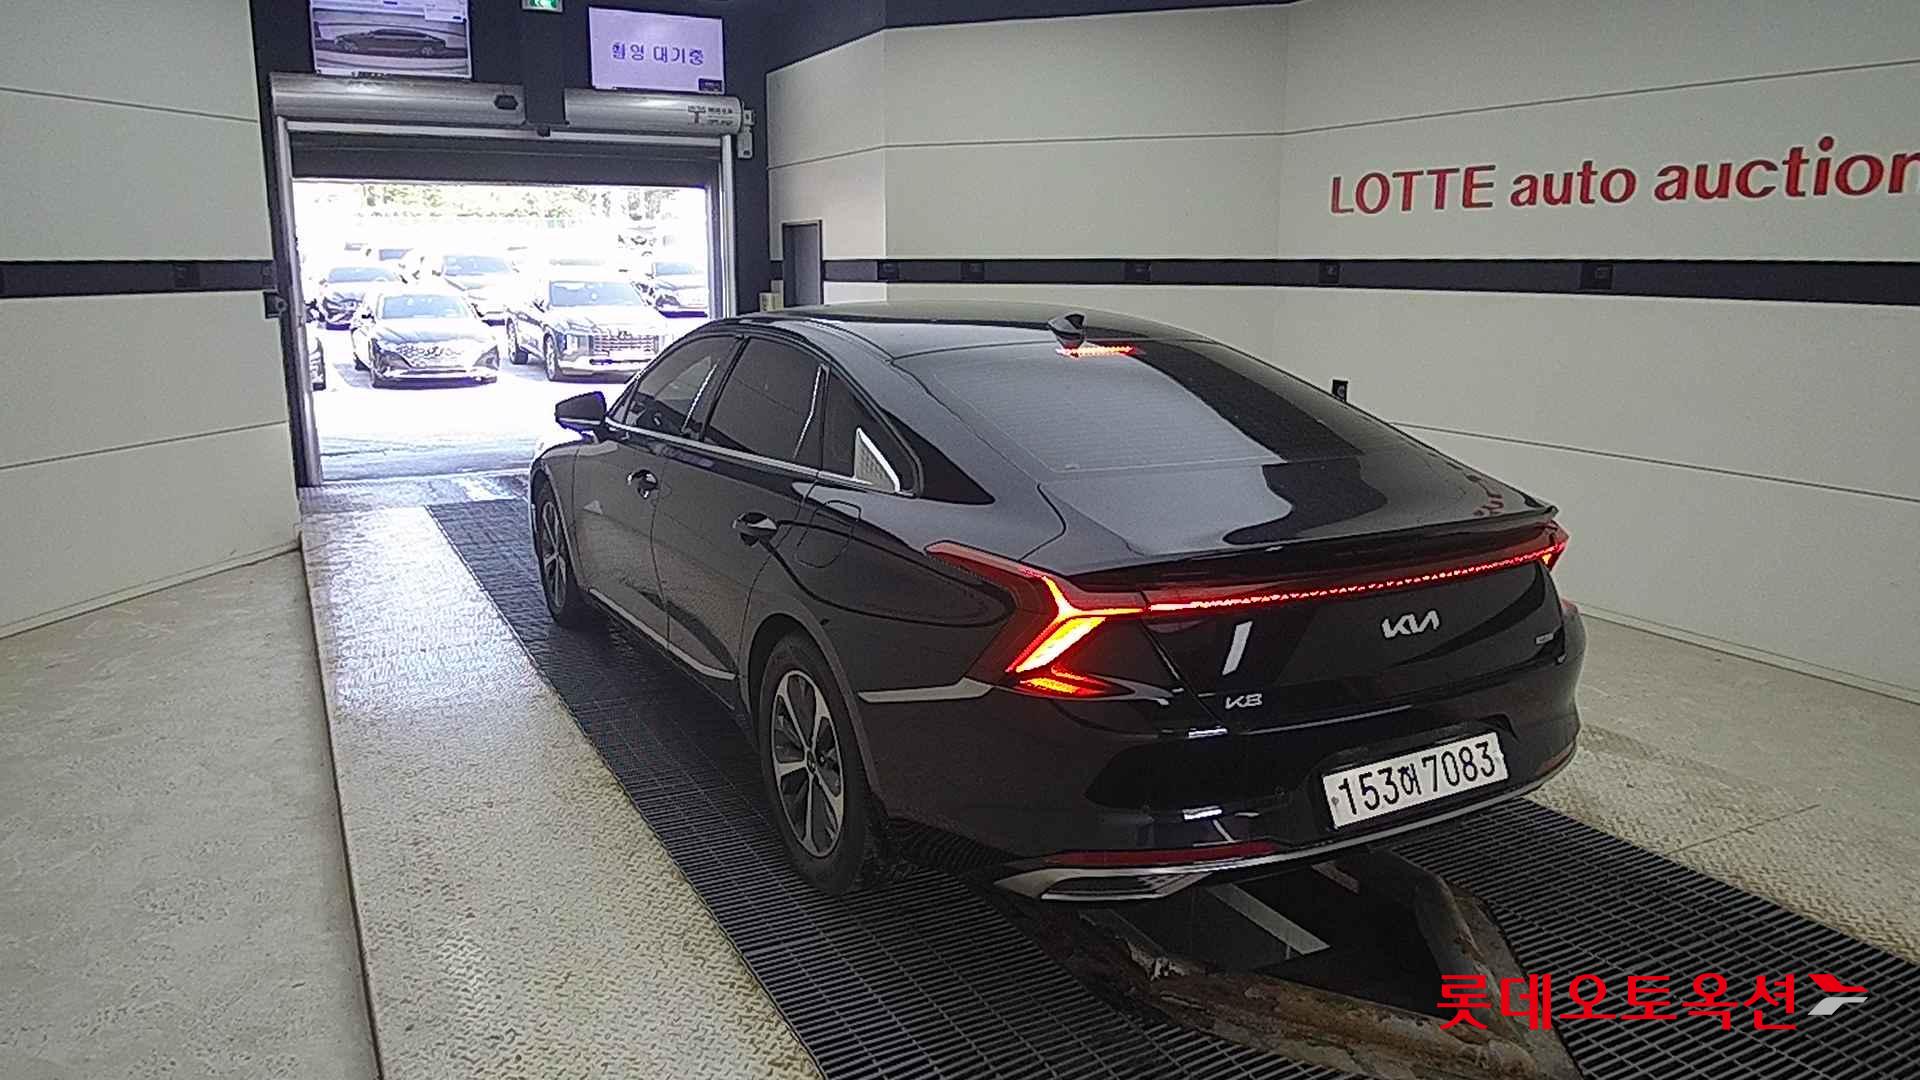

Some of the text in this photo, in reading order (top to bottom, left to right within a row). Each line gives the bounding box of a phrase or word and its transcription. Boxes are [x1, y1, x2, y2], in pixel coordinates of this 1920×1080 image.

[653, 46, 704, 66] 대기중
[1331, 164, 1496, 215] LOTTE
[1510, 160, 1637, 208] auto
[1382, 610, 1440, 638] KIA
[1225, 693, 1262, 709] K8
